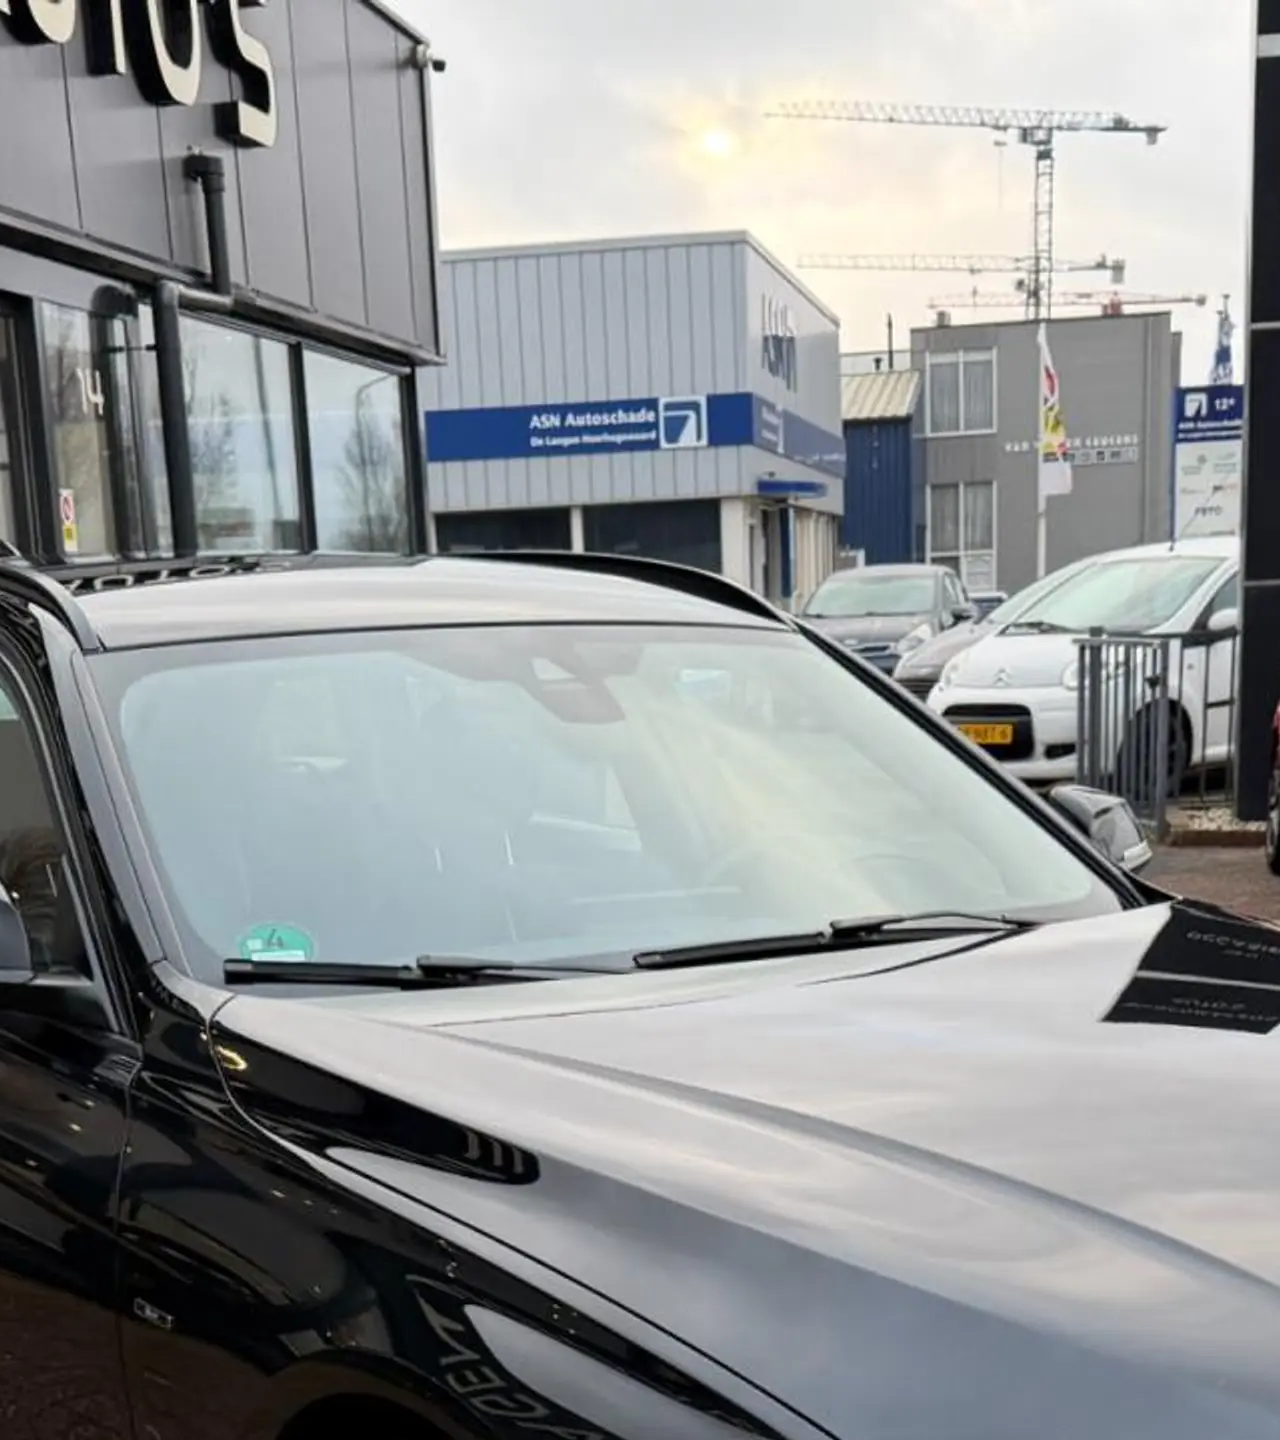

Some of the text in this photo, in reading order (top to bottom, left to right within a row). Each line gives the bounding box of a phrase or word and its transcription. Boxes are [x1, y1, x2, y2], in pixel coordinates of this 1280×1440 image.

[75, 367, 105, 416] 14
[529, 406, 656, 430] ASN Autoschade
